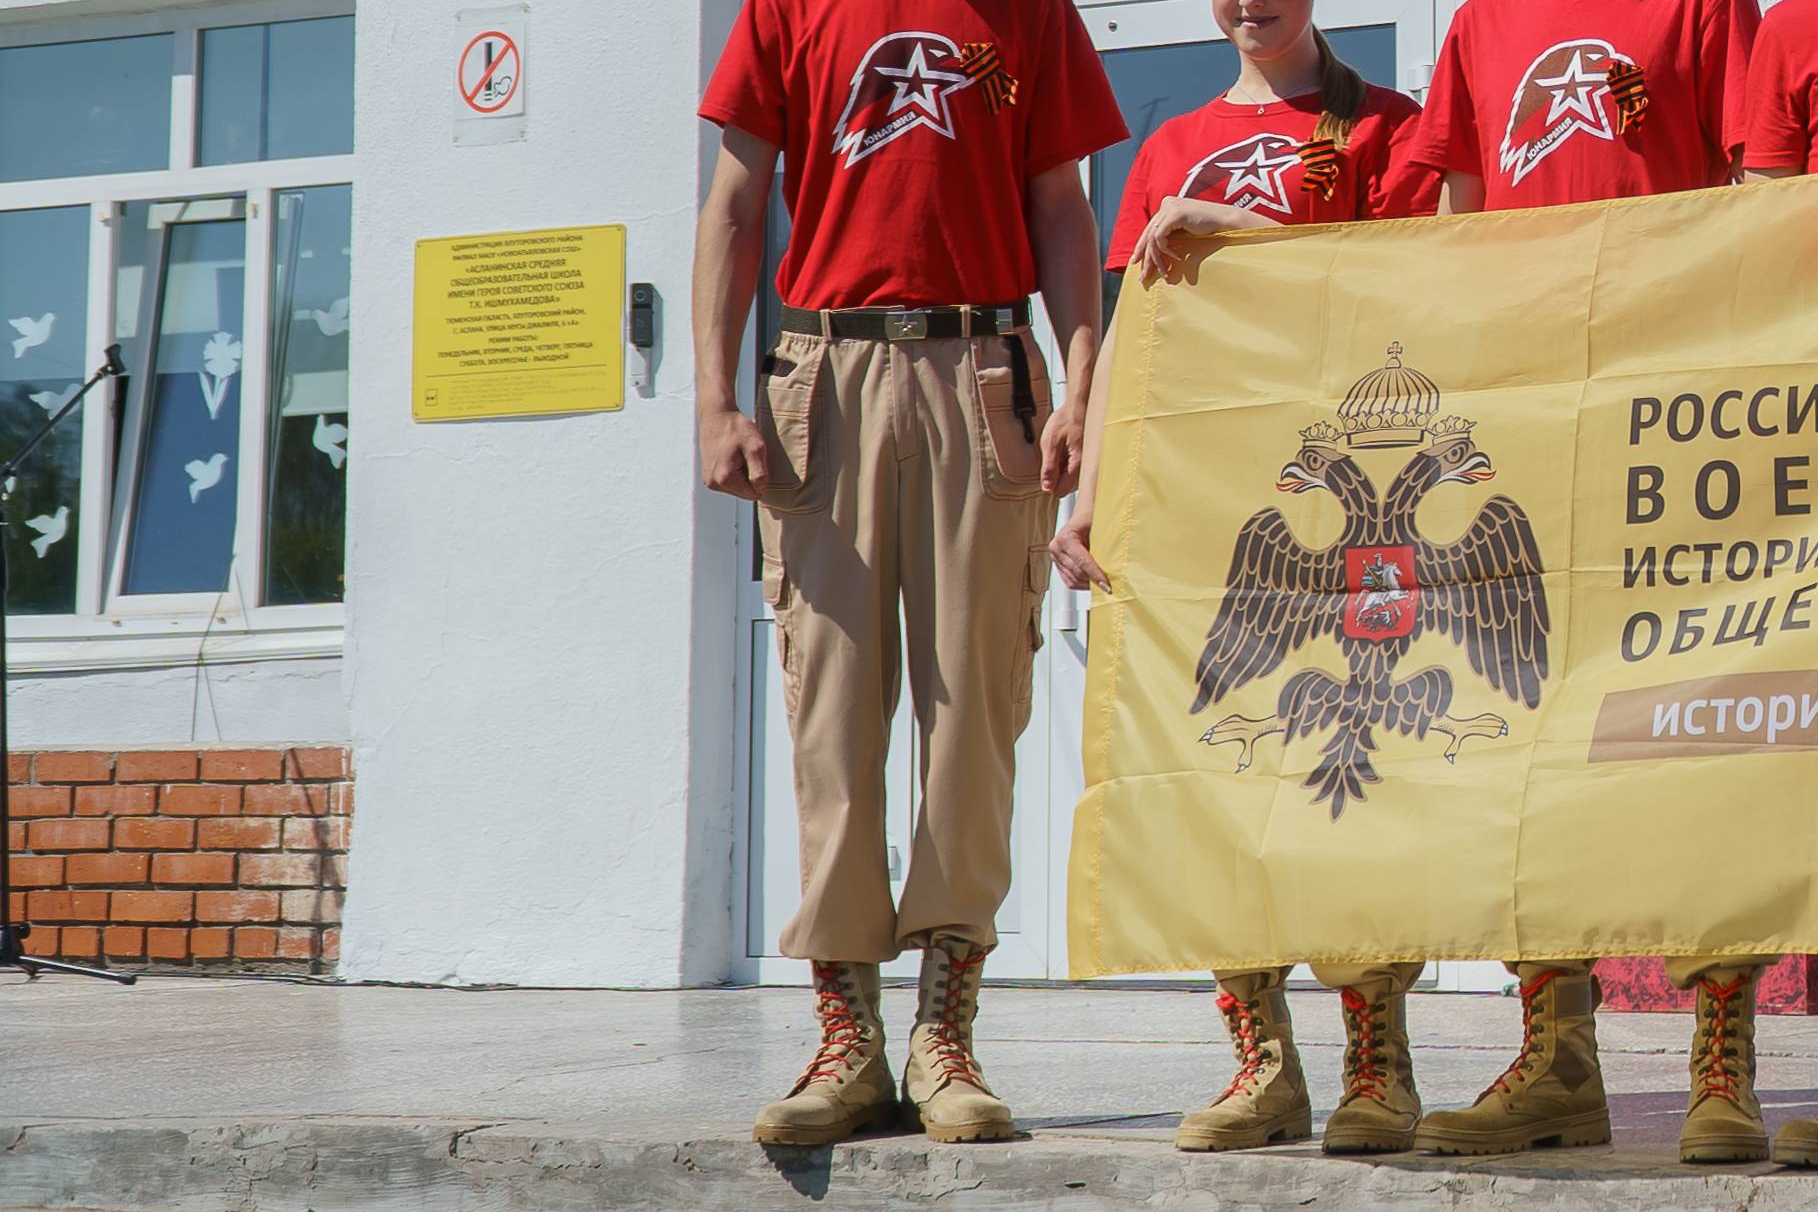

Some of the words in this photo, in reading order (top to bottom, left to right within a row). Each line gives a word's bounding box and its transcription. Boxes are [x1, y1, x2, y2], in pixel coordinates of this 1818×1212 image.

[863, 110, 916, 146] ЮНАРМИЯ
[1527, 116, 1573, 159] ЮНАРМИЯ
[477, 287, 500, 296] ГЕРОЯ
[502, 284, 552, 295] СОВЕТСКОГО
[555, 281, 584, 291] СОЮЗА
